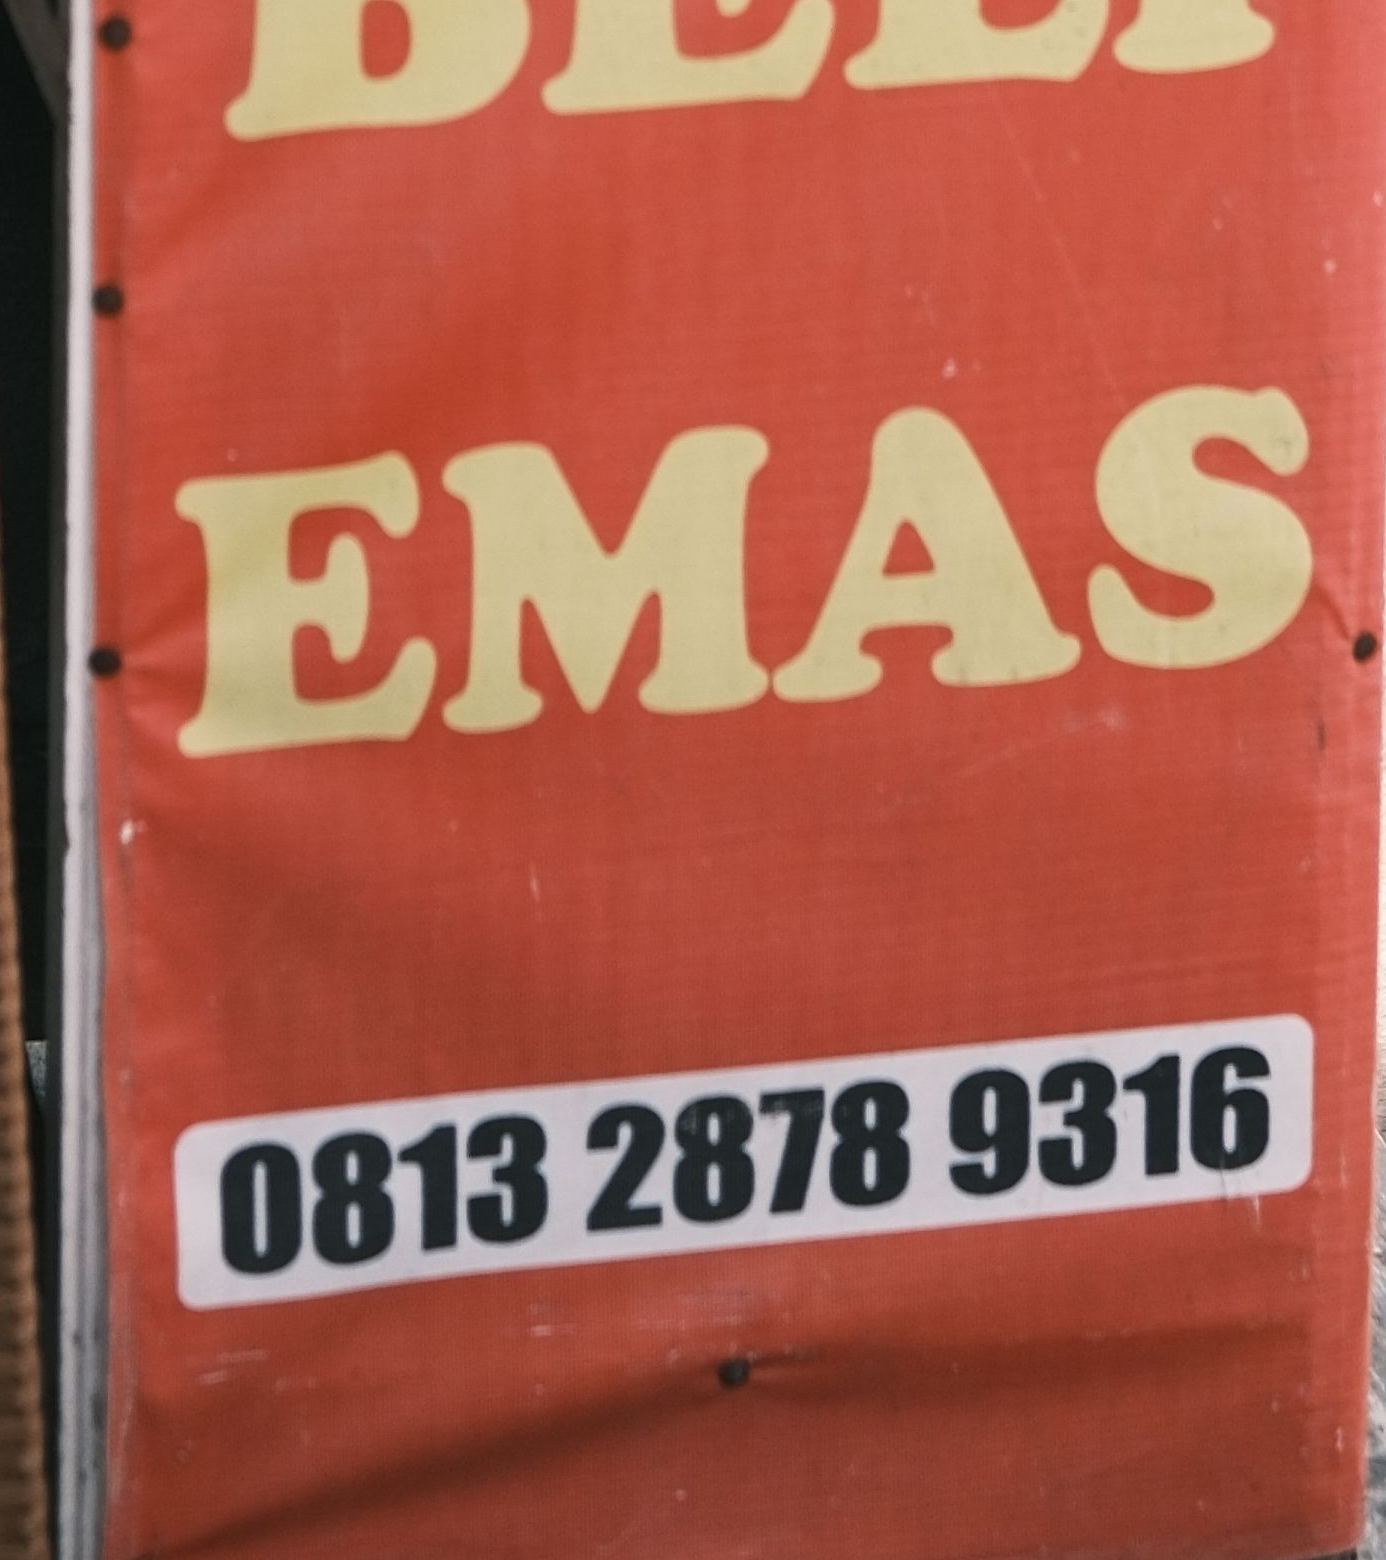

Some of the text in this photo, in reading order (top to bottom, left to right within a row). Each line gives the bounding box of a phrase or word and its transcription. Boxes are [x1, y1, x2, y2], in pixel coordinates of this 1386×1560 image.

[173, 383, 1315, 759] EMAS
[219, 1044, 1273, 1276] 0813 2878 9316
